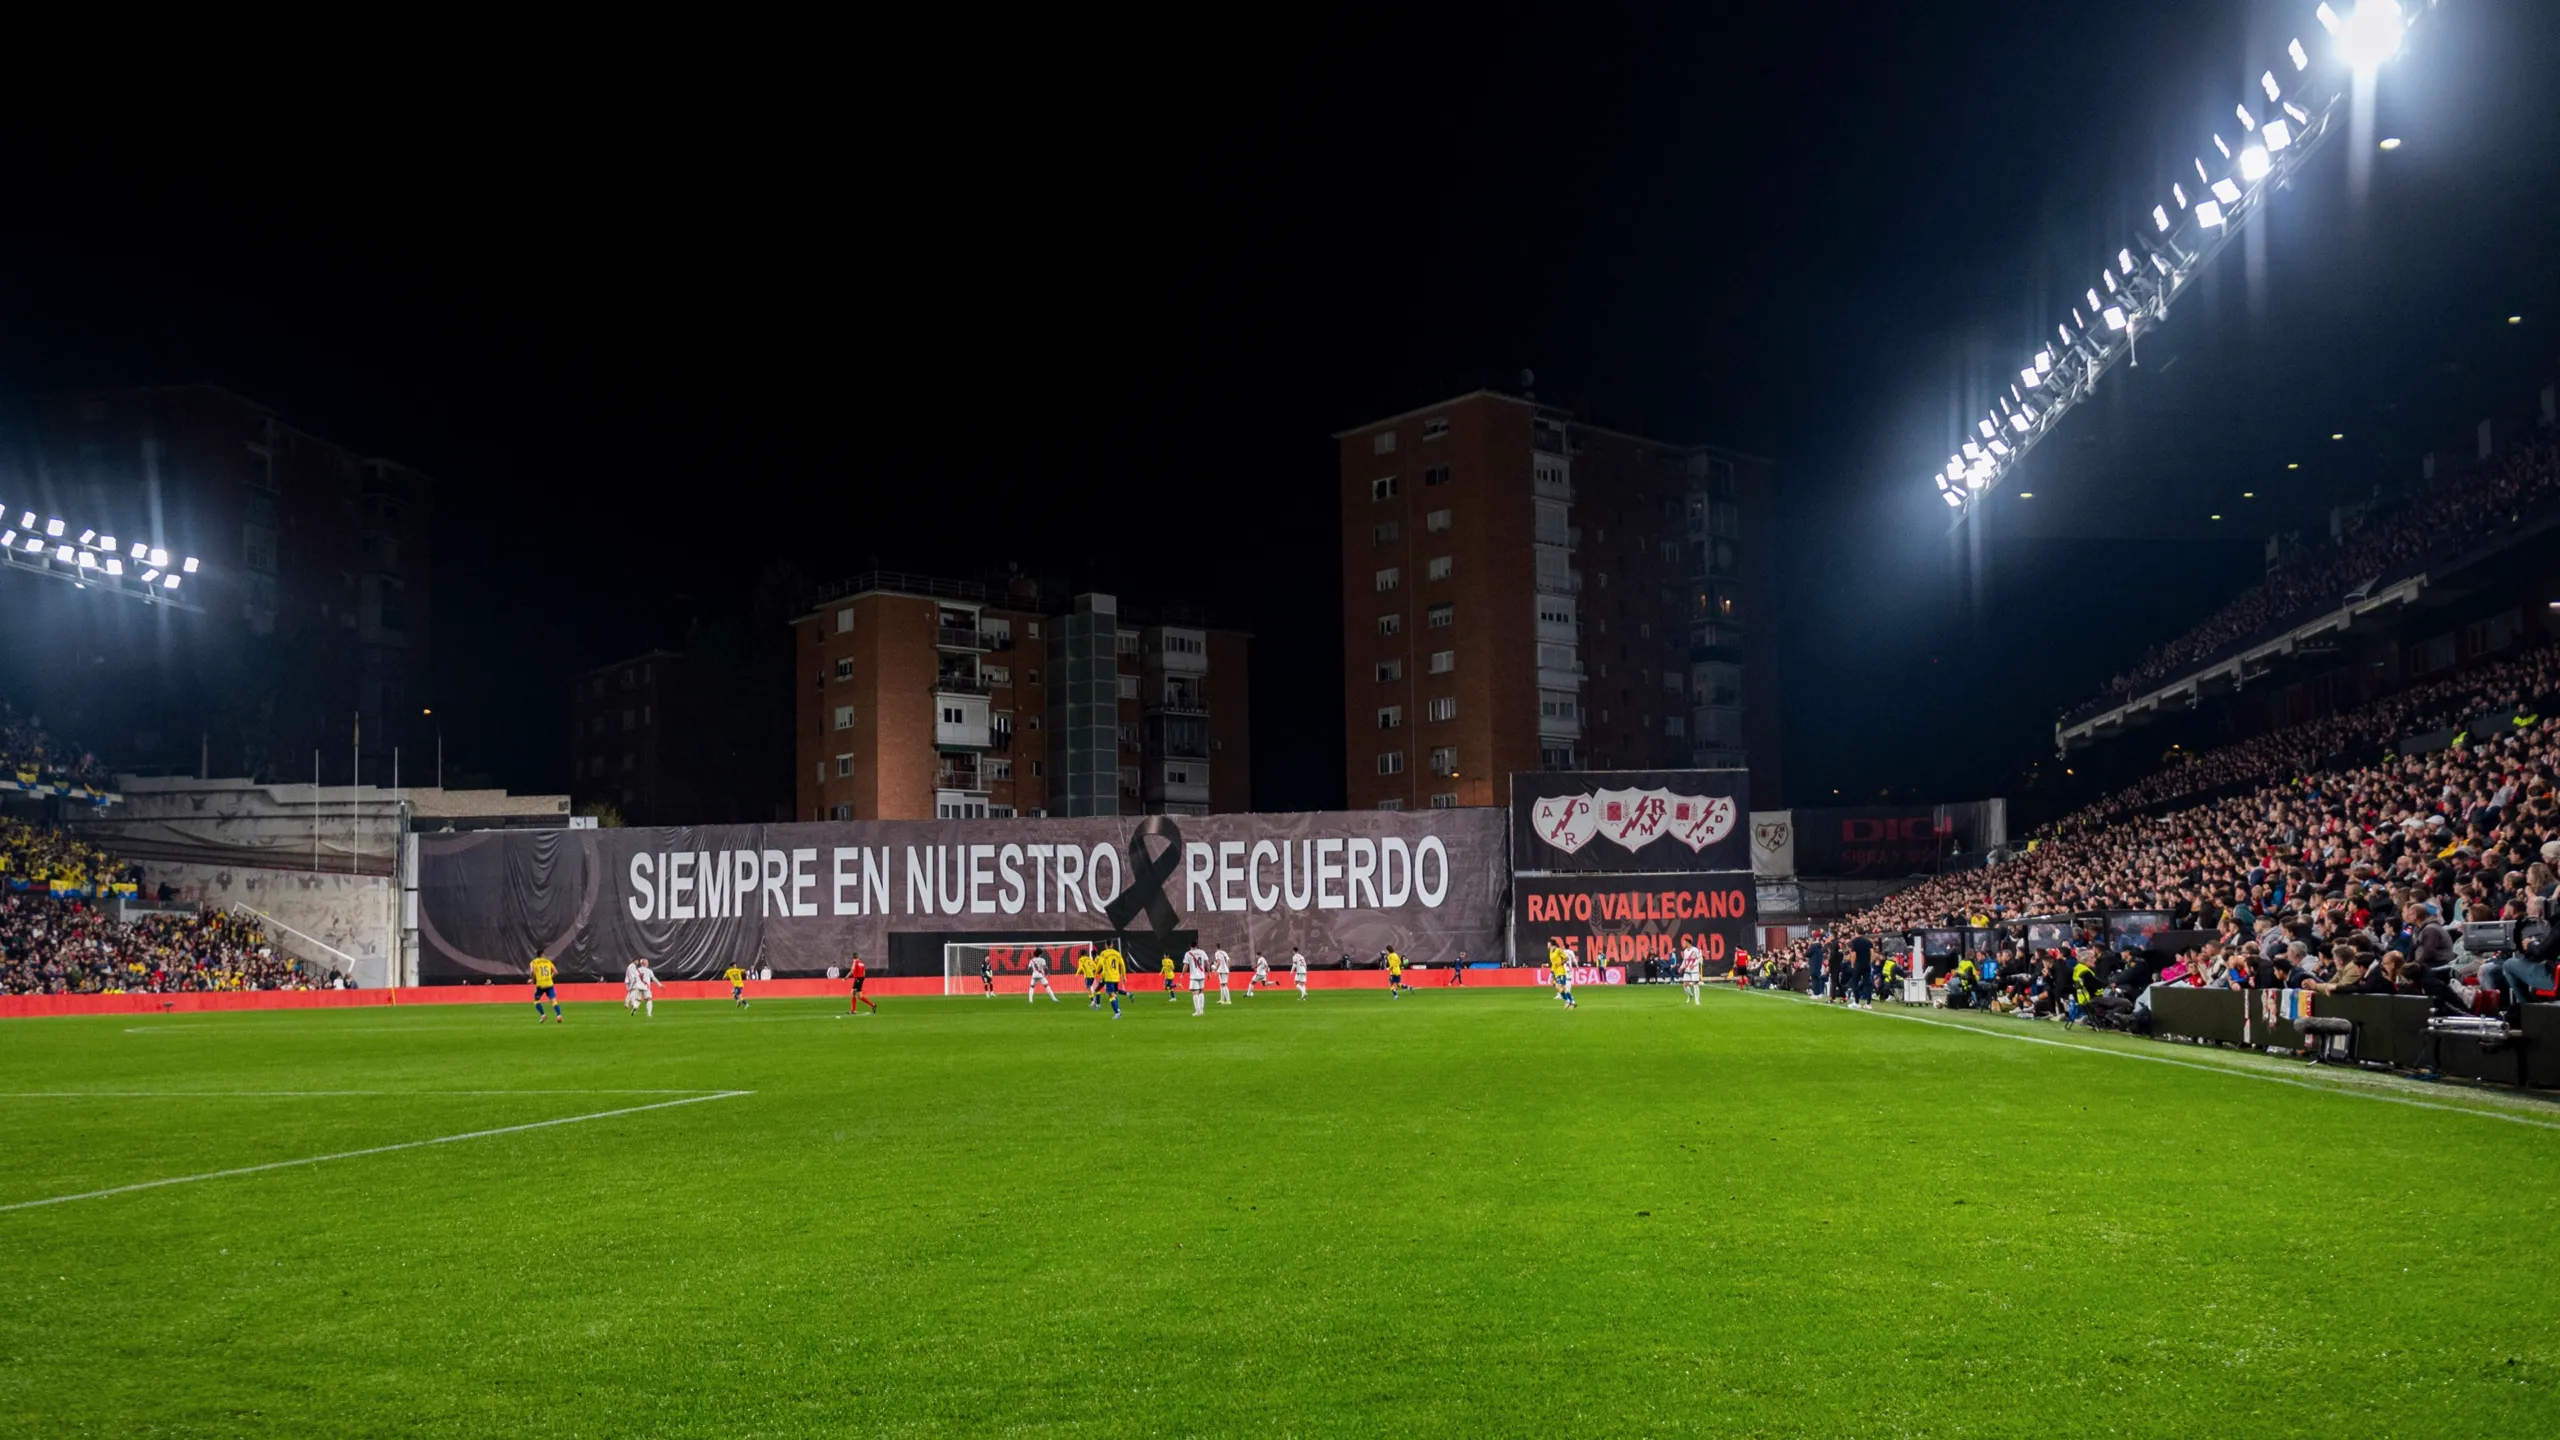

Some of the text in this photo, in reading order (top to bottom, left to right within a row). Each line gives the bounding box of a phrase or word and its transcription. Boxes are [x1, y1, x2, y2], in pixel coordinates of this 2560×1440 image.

[628, 836, 1449, 921] SIEMPRE EN NUESTRO RECUERDO
[1528, 890, 1745, 922] RAYO VALLECANO
[1586, 934, 1675, 963] MADRID
[1536, 969, 1600, 985] LIGA
